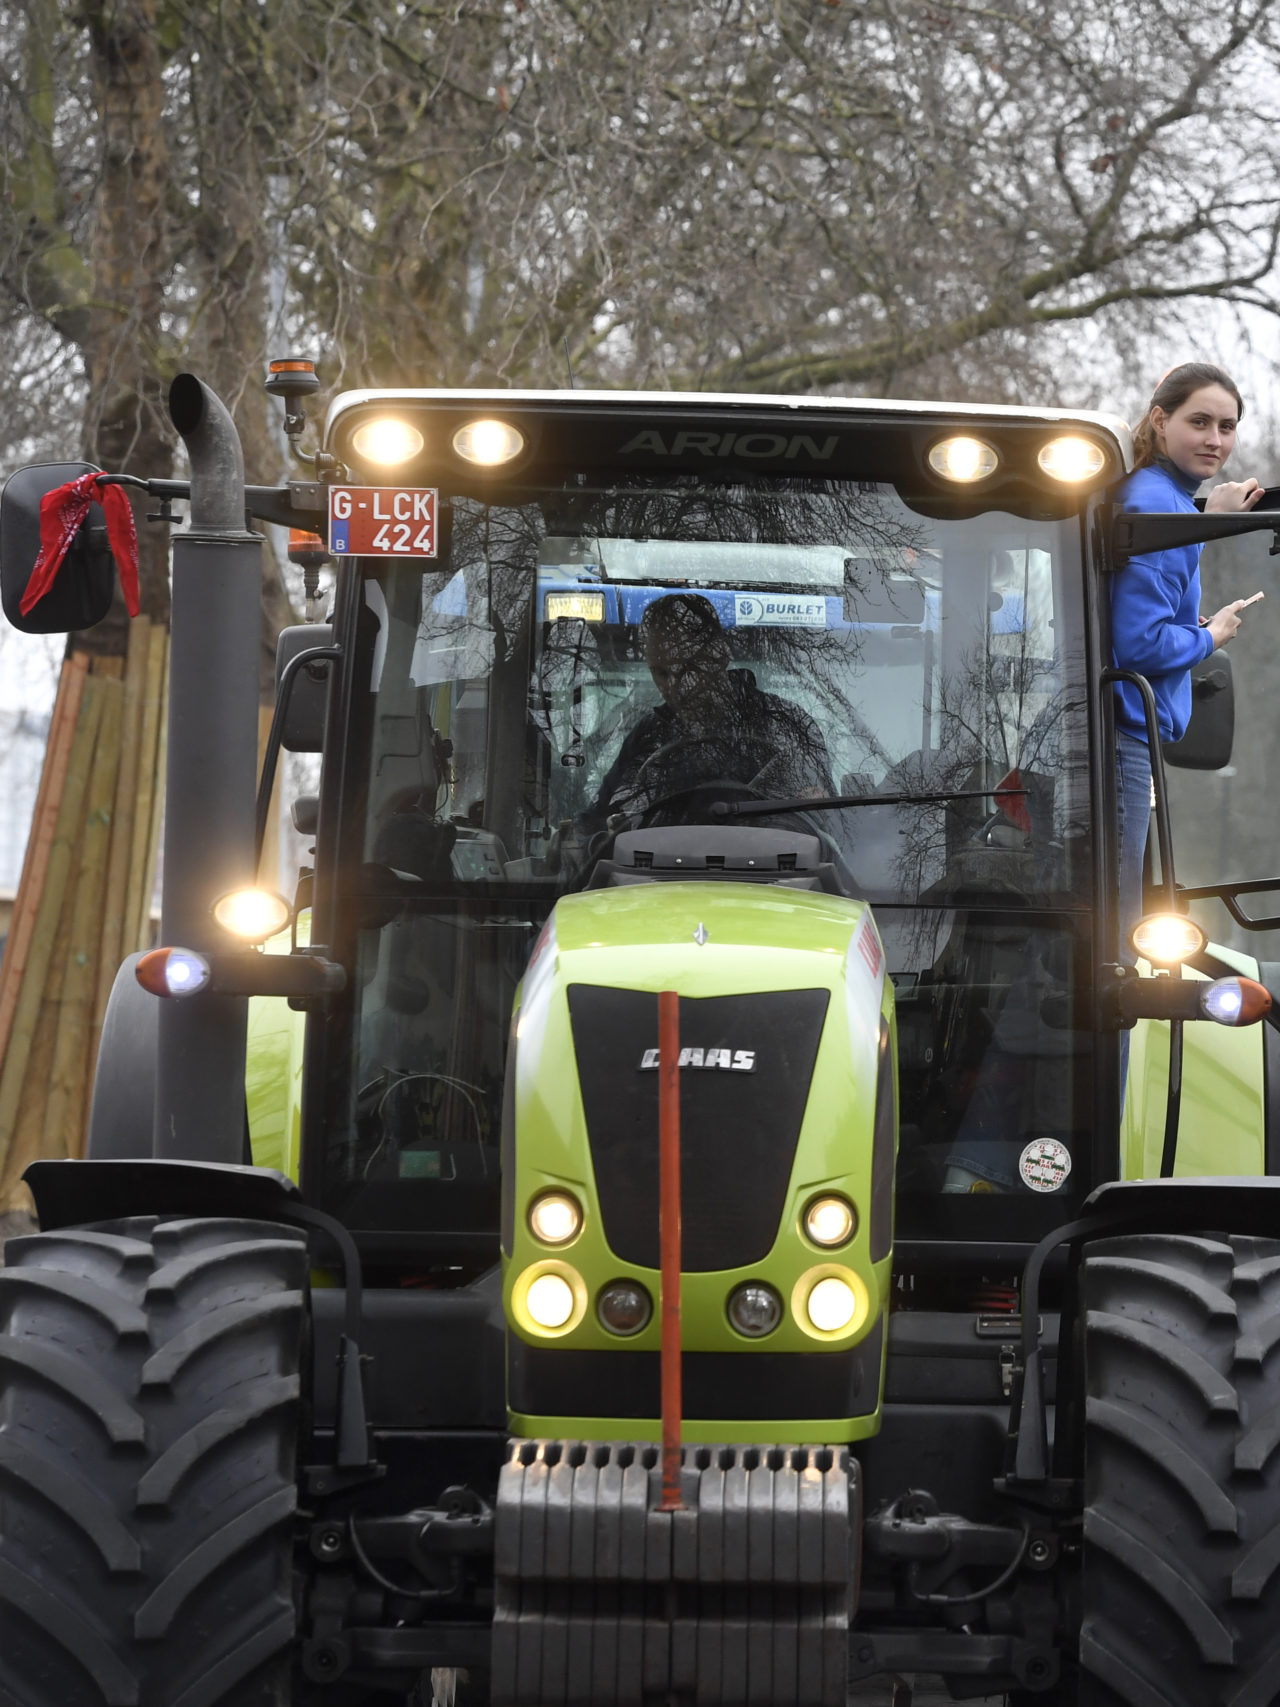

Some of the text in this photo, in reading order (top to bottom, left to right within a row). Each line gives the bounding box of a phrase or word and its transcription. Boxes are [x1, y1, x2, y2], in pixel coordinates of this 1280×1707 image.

[617, 430, 840, 460] ARION
[333, 491, 432, 521] G-LCK
[335, 539, 346, 550] B
[372, 523, 431, 552] 424
[765, 603, 824, 615] BURLET
[641, 1047, 756, 1070] CAAS
